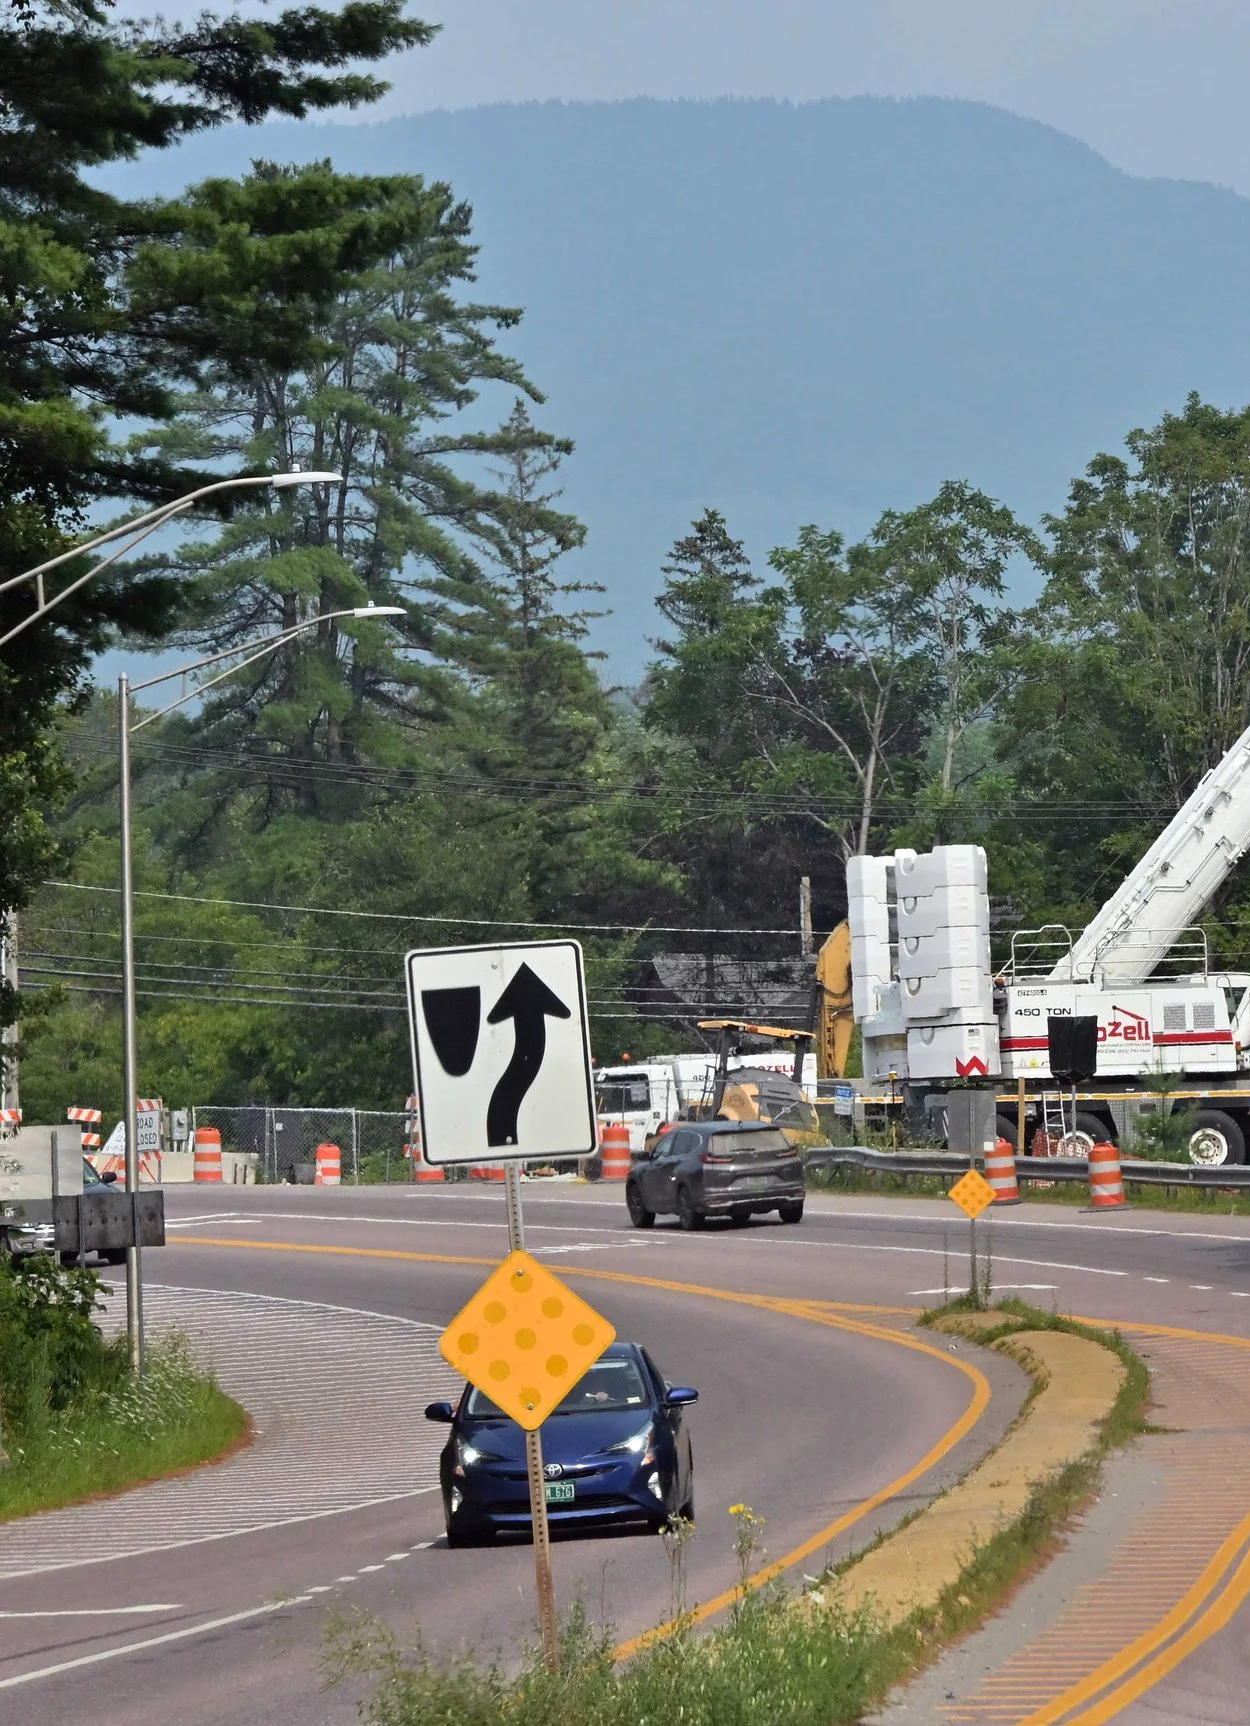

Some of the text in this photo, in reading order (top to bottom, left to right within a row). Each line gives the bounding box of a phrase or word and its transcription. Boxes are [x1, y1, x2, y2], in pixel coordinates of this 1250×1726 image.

[1015, 1008, 1071, 1016] 450 TON
[757, 1064, 796, 1074] OZELL
[556, 1486, 571, 1498] 676
